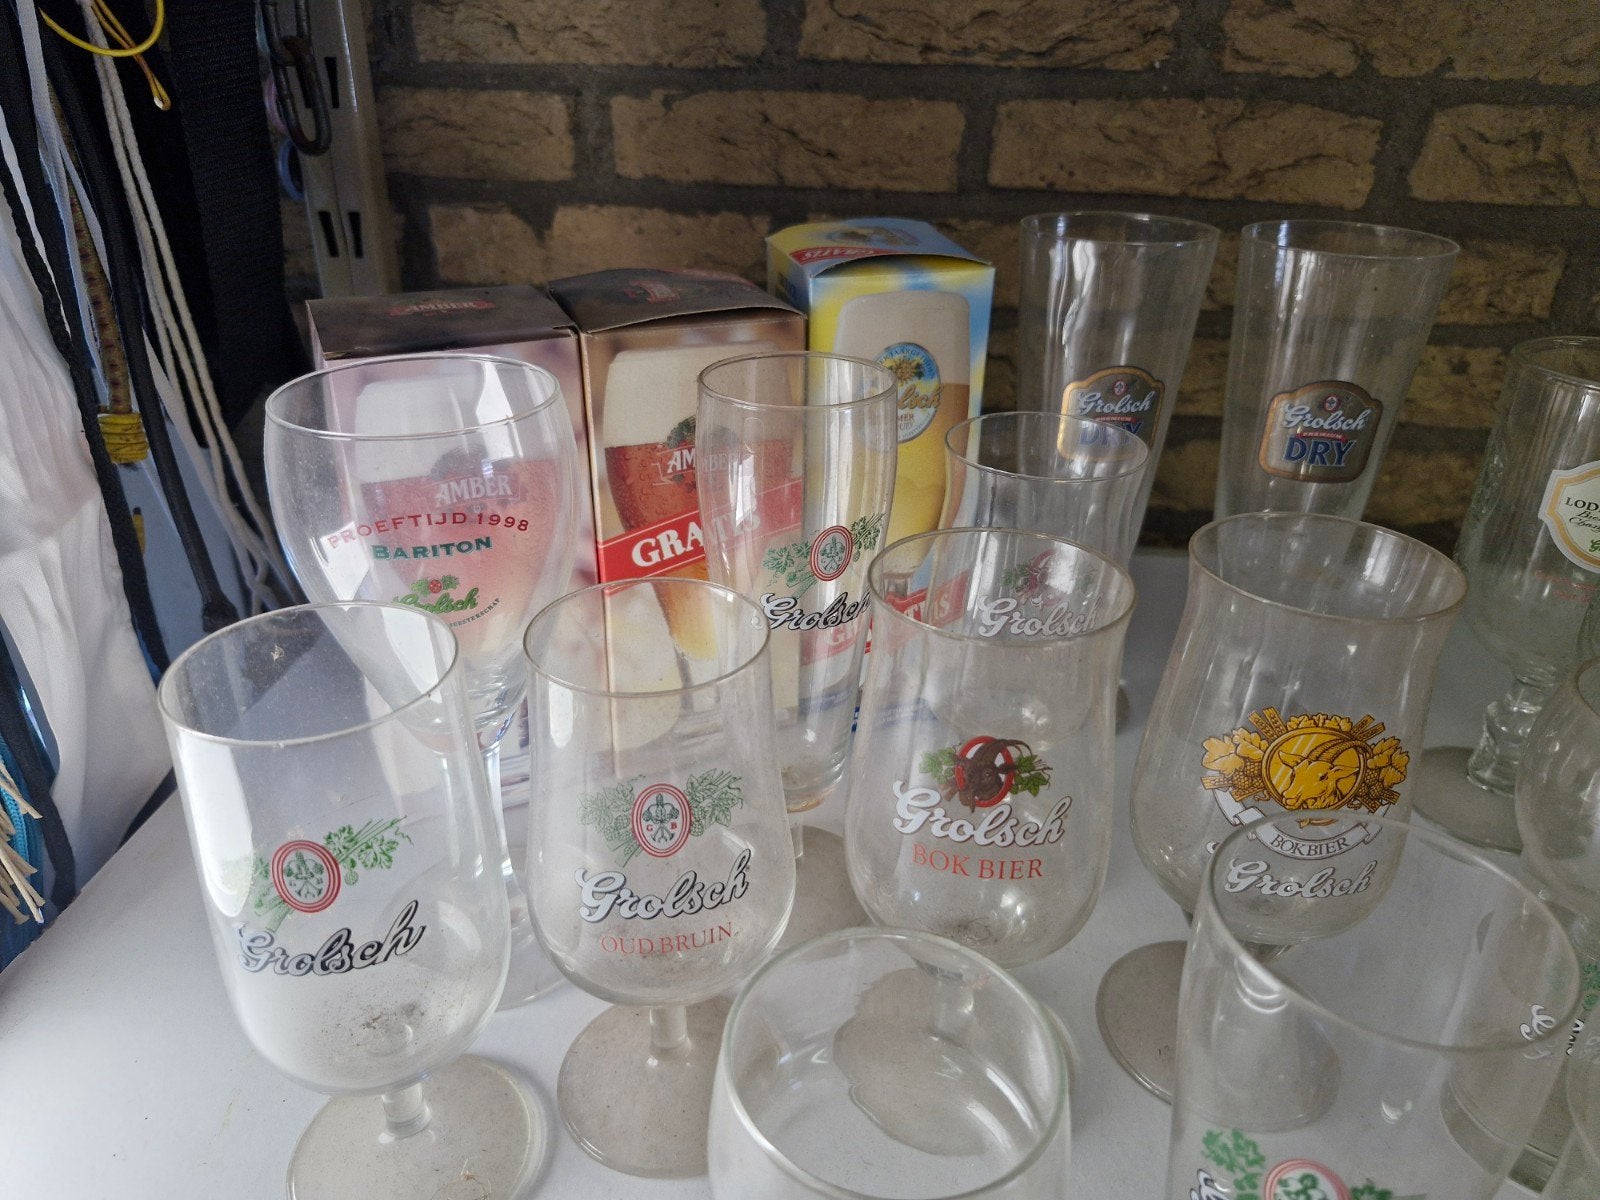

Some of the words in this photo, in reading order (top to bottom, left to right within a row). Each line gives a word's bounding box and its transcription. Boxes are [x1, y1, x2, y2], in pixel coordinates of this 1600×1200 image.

[405, 302, 478, 314] AMBER
[1077, 391, 1156, 416] Grolsch
[1283, 404, 1372, 430] Grolsch
[1283, 437, 1357, 467] DRY
[434, 474, 512, 505] AMBER
[1565, 497, 1600, 512] LOD
[327, 512, 468, 549] PROEFTIJD
[477, 514, 530, 532] 1998
[371, 536, 493, 560] BARITON
[760, 591, 872, 631] Grolsch
[978, 596, 1102, 637] Grolsch
[892, 780, 1073, 847] Grolsch
[912, 843, 970, 877] BOK
[978, 859, 1044, 881] BIER
[1224, 860, 1378, 899] Grolsch
[574, 848, 752, 924] Grolsch
[233, 899, 427, 976] Grolsch
[601, 935, 653, 955] OUD
[660, 921, 733, 955] BRUIN
